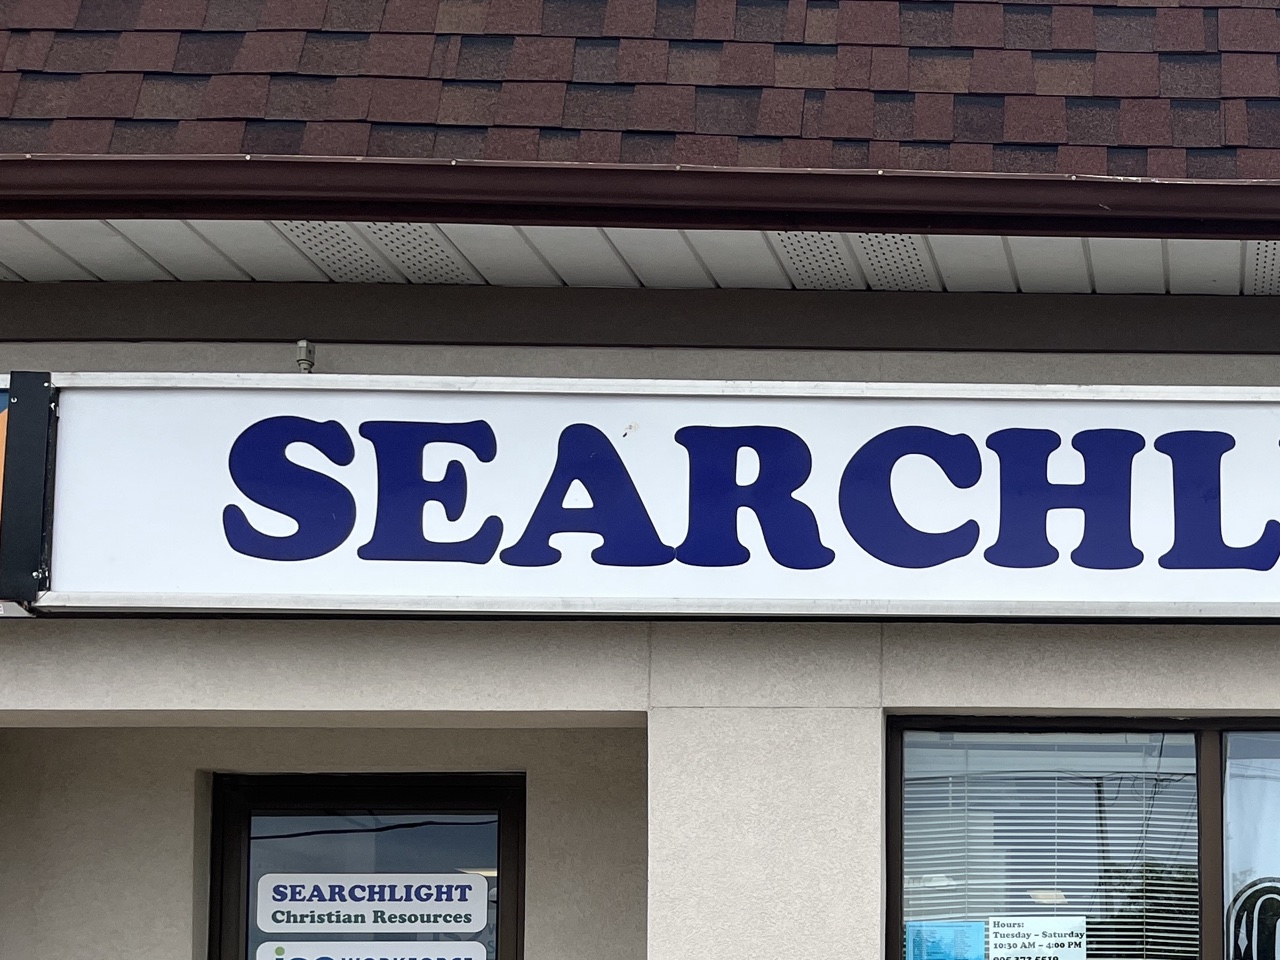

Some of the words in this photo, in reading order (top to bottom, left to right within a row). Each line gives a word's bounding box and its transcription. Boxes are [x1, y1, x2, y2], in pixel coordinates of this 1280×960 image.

[271, 884, 473, 902] SEARCHLIGHT
[271, 910, 367, 924] Christian
[372, 910, 473, 924] Resources
[993, 931, 1032, 940] Tuesday
[1041, 931, 1085, 940] Saturday
[993, 942, 1018, 950] 10:30
[1045, 942, 1065, 950] 4:00
[1067, 941, 1082, 949] PM
